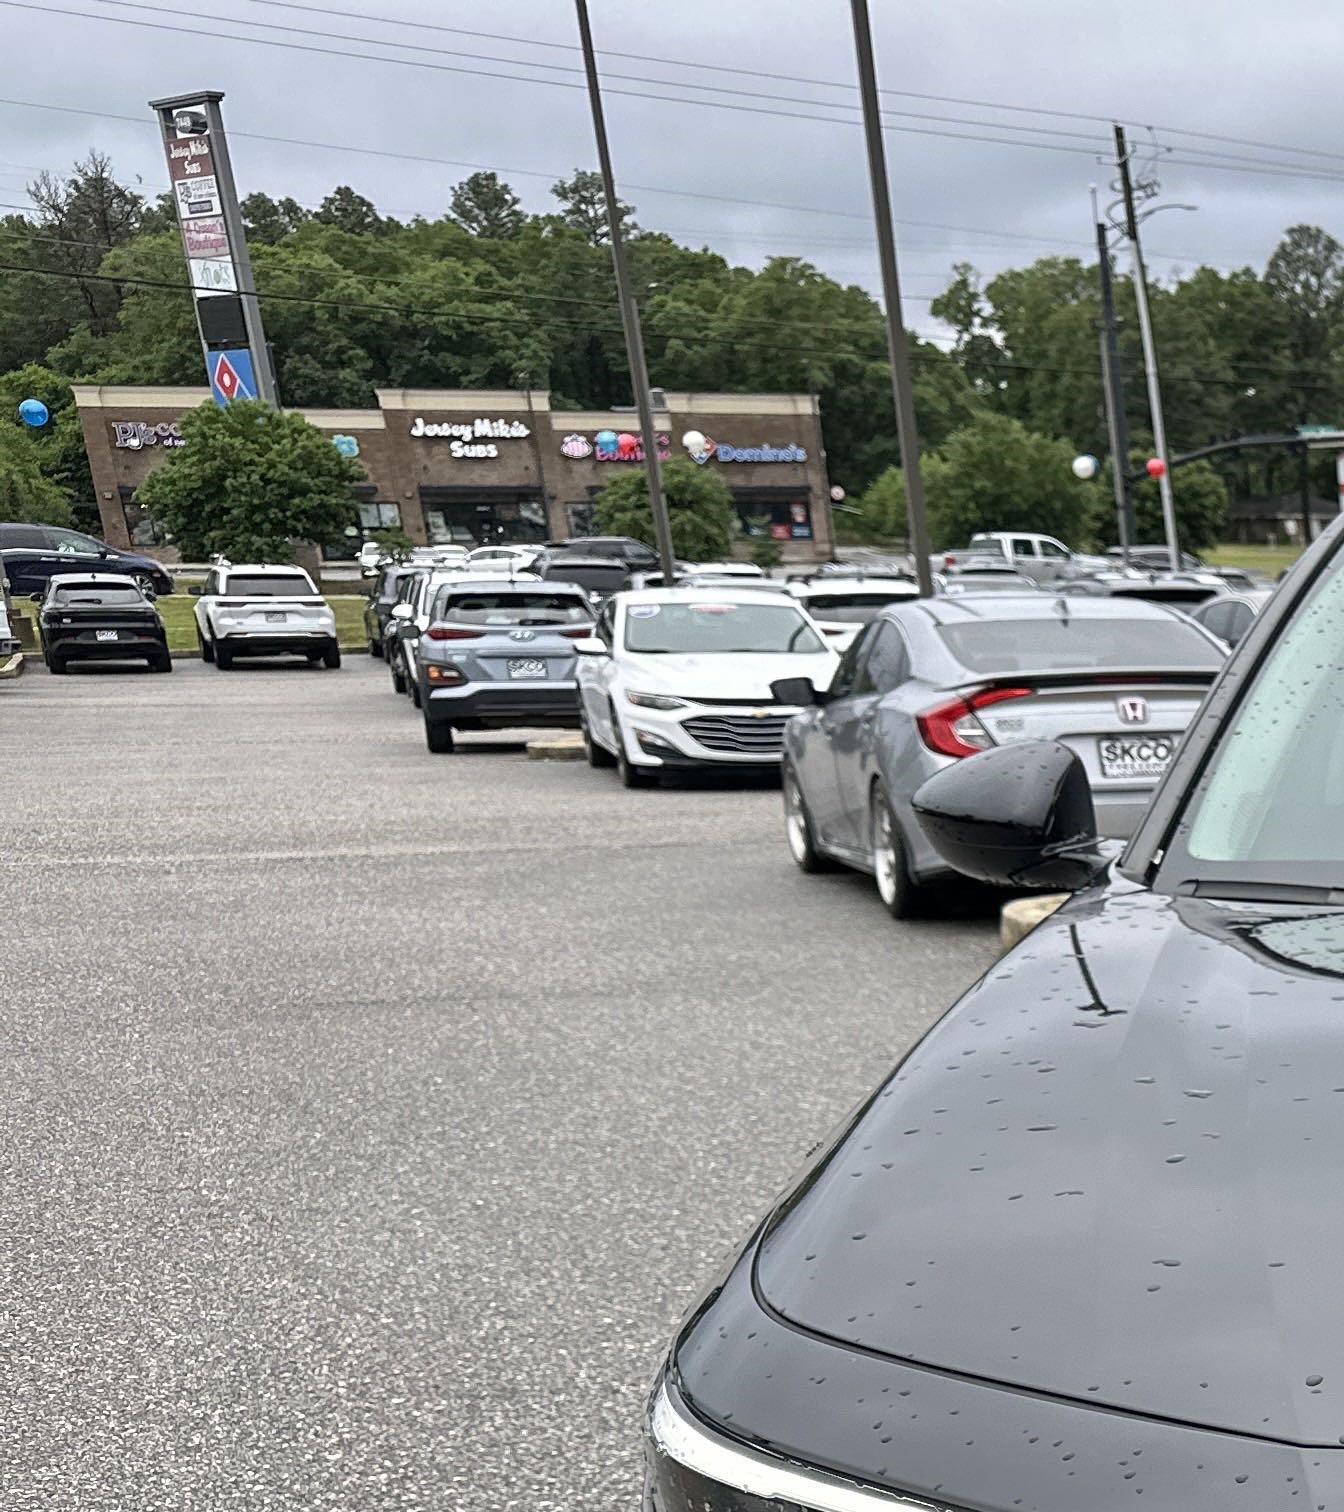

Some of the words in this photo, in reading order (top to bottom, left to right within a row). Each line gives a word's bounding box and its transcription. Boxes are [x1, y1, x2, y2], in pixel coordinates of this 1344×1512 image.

[410, 417, 473, 441] Jersey
[473, 418, 531, 438] Mike's
[449, 440, 498, 458] Subs
[717, 442, 808, 462] Domino's
[1104, 743, 1170, 762] SKCO
